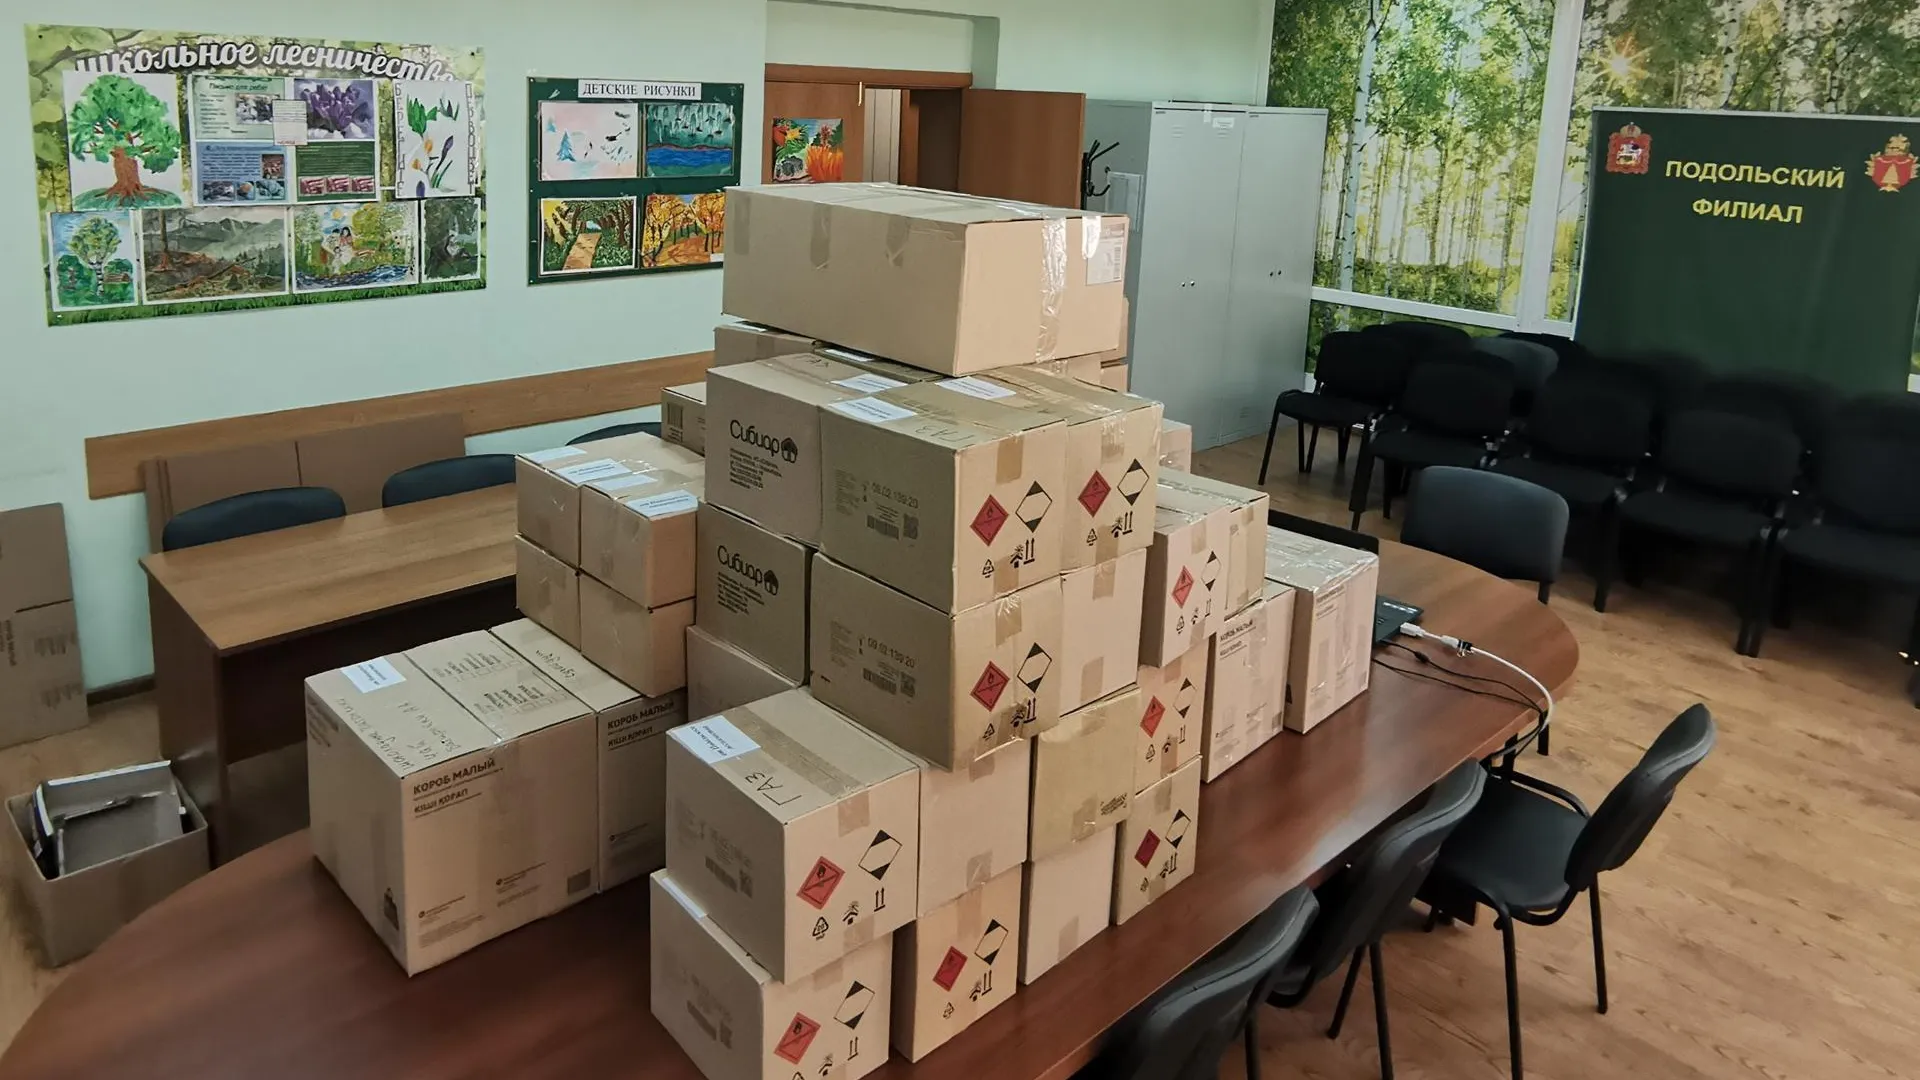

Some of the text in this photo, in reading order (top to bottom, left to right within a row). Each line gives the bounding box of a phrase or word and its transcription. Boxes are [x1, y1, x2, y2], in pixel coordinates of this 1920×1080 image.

[582, 82, 697, 98] ДЕТСКИЕ РИСУНКИ
[1664, 159, 1846, 189] ПОДОЛЬСКИЙ
[1691, 197, 1803, 224] ФИЛИАЛ
[729, 419, 780, 458] Сибиар
[717, 545, 763, 587] Сибиар
[607, 713, 639, 730] КОРОБ
[413, 757, 496, 795] КОРОБ МАЛЫЙ
[744, 771, 803, 806] ГАЗ
